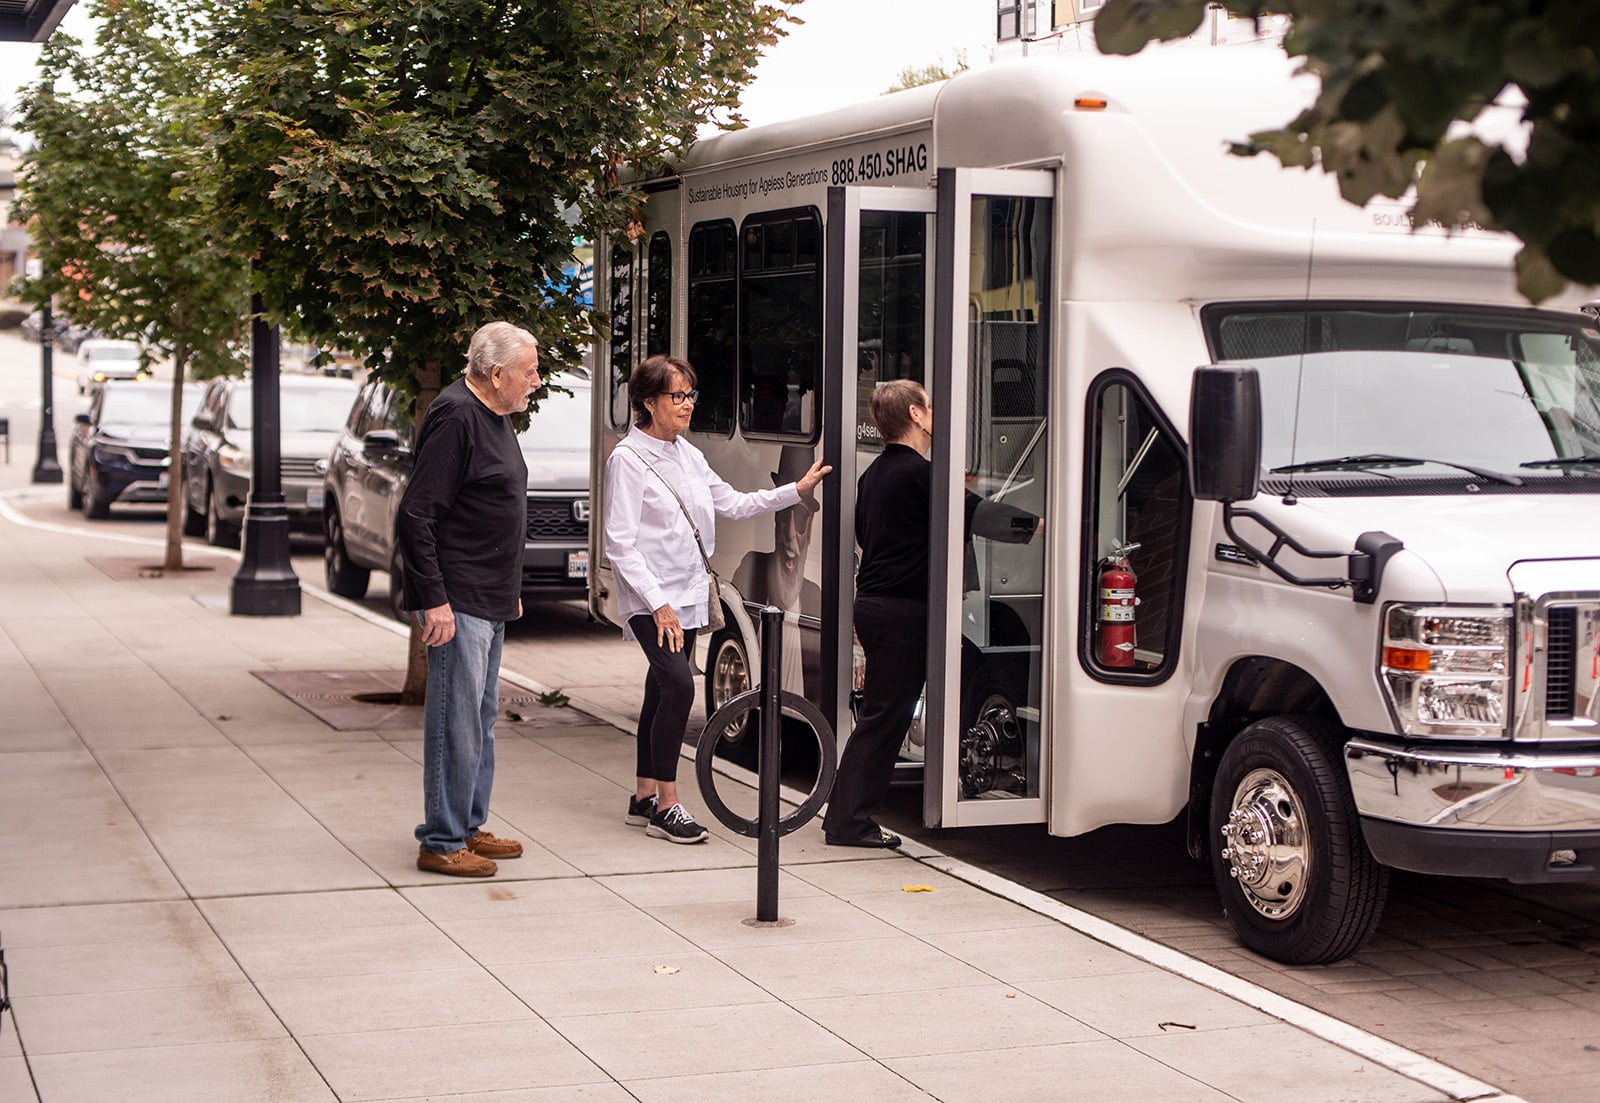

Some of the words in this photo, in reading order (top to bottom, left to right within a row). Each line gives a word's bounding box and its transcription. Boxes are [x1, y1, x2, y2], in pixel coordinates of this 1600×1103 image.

[688, 187, 721, 204] Sustainable
[722, 181, 748, 199] Housing
[749, 178, 758, 194] for
[759, 177, 784, 196] Ageless
[786, 168, 828, 188] Generations
[832, 143, 927, 185] 888.450.SHAG
